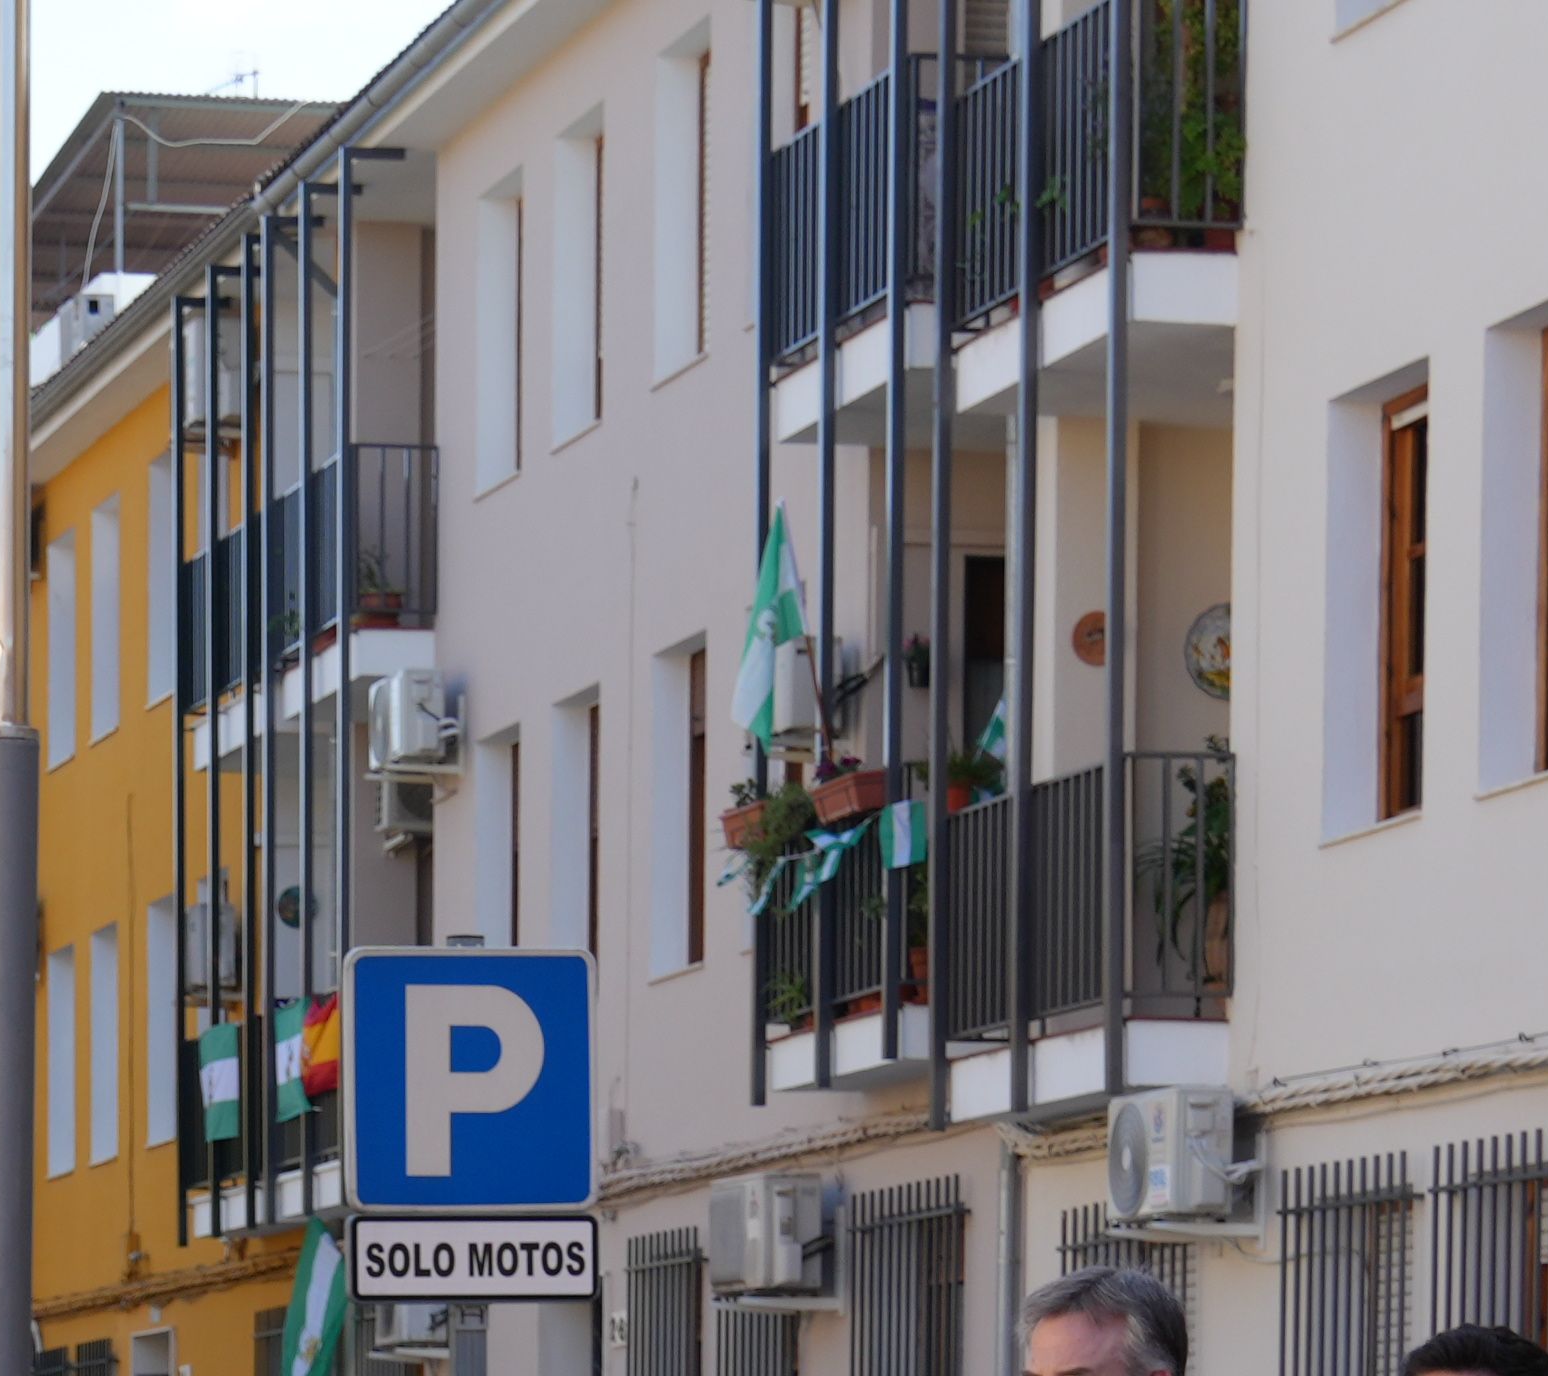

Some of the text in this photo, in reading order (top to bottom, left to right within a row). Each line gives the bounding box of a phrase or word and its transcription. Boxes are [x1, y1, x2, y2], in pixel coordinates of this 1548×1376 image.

[405, 984, 544, 1176] P
[365, 1241, 585, 1277] SOLO MOTOS
